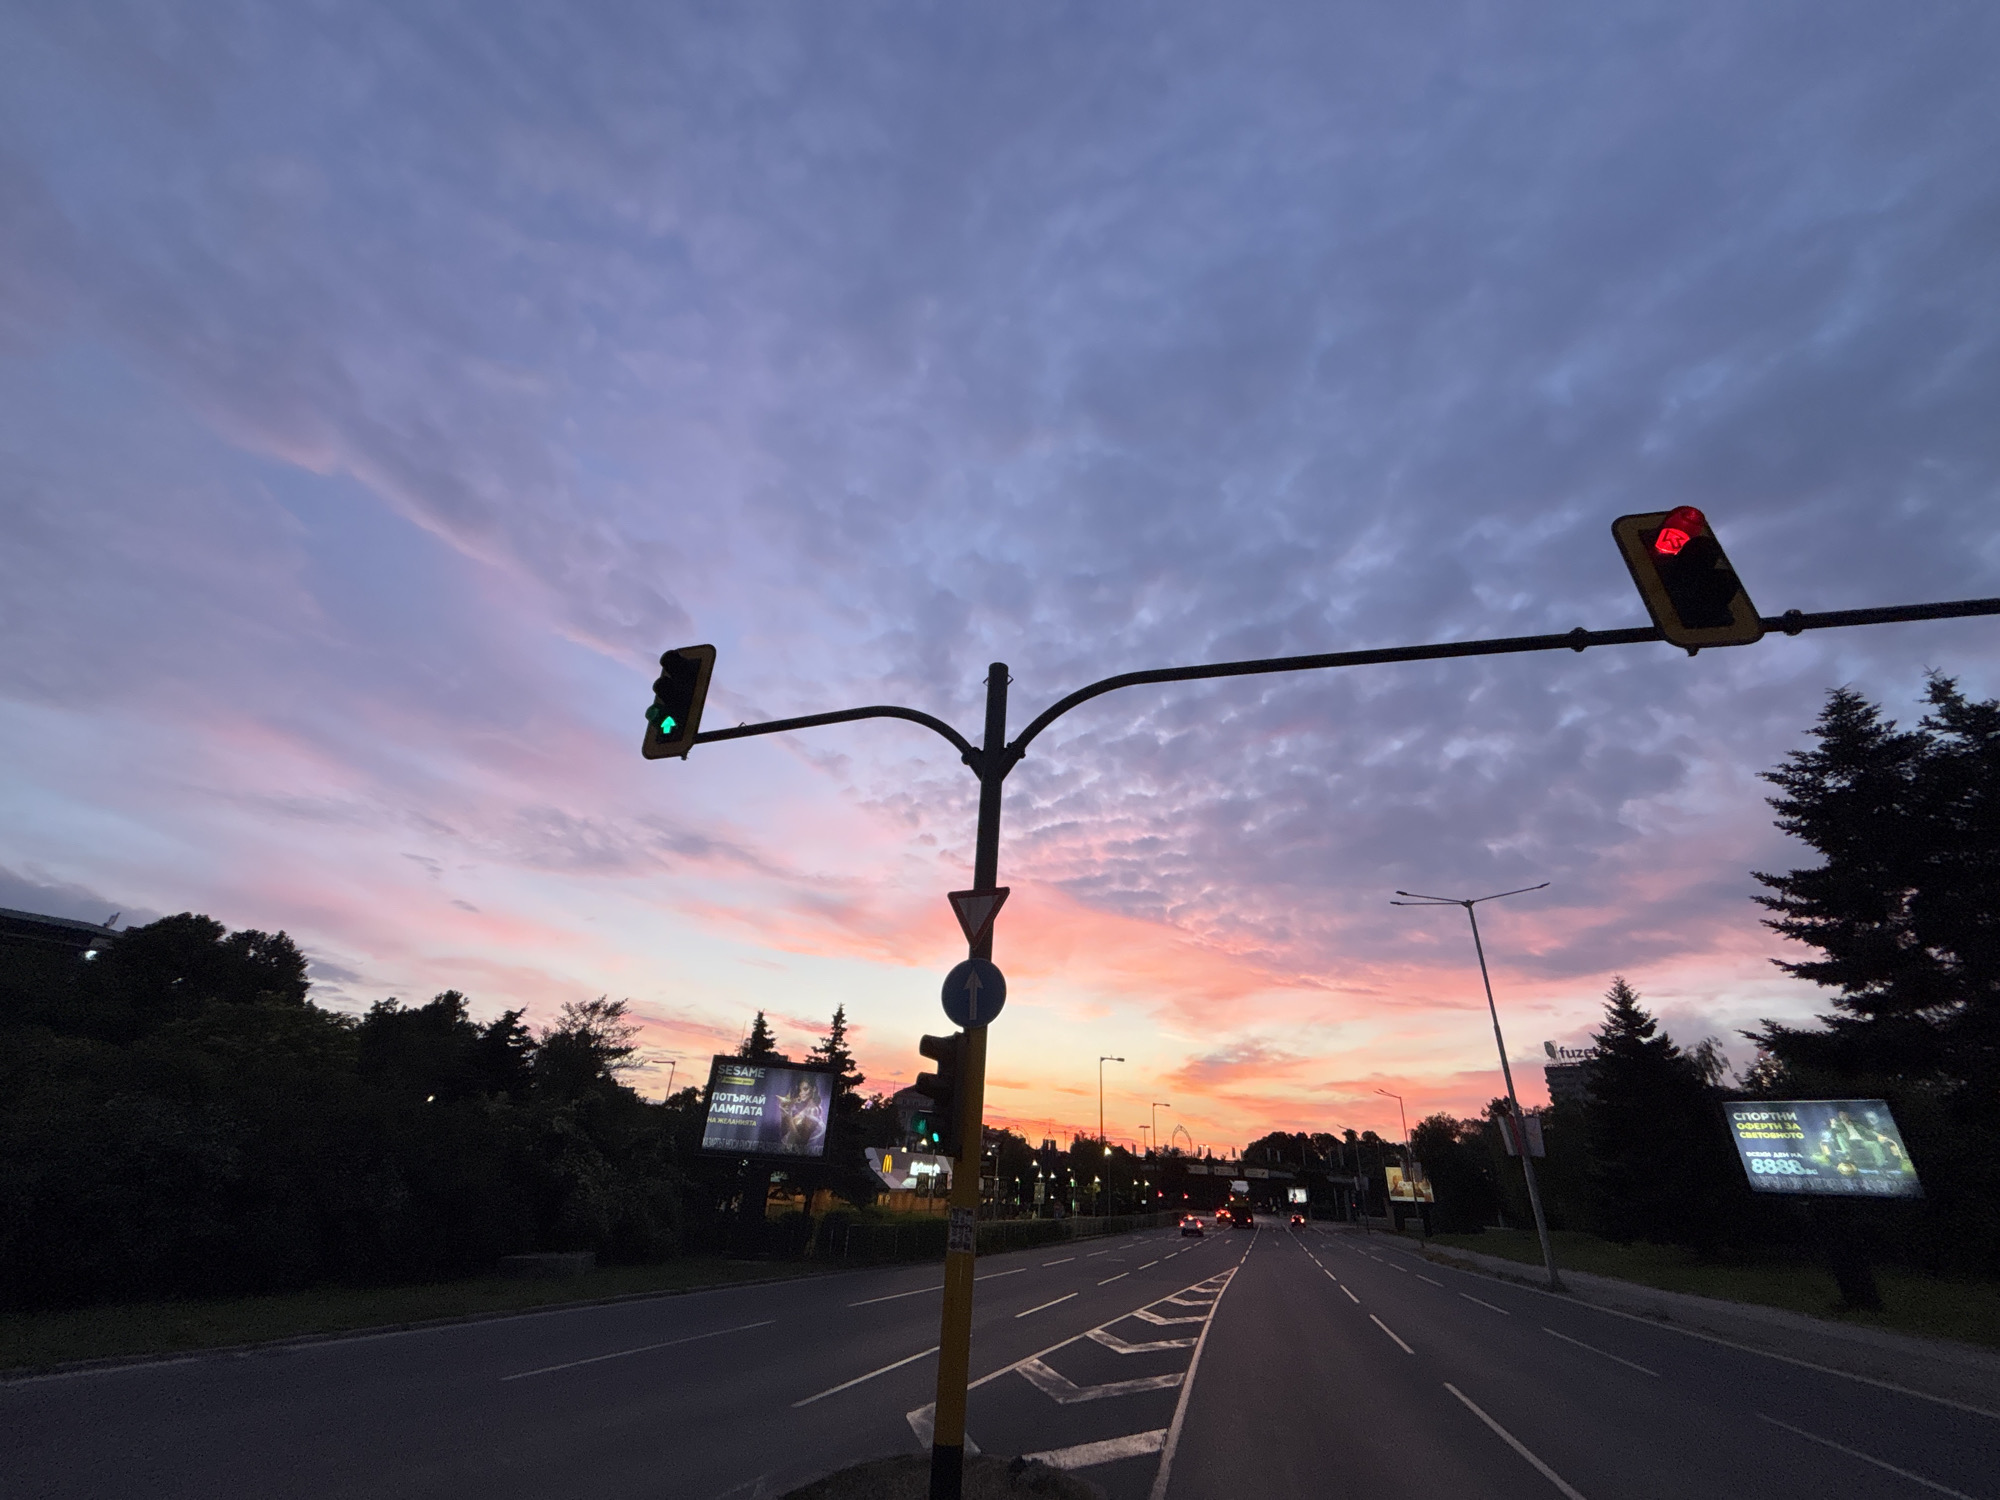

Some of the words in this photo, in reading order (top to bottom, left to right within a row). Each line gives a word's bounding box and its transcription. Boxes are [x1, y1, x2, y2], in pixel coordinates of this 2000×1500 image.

[717, 1064, 766, 1078] SESAME
[712, 1092, 766, 1105] ПОТЪРКАЙ
[709, 1103, 763, 1116] ЛАМПАТА
[1733, 1112, 1798, 1121] СПОРТНИ
[1736, 1122, 1783, 1130] ОФЕРТИ
[1784, 1122, 1802, 1131] ЗА
[1739, 1131, 1805, 1139] СВЕТОВНОТО
